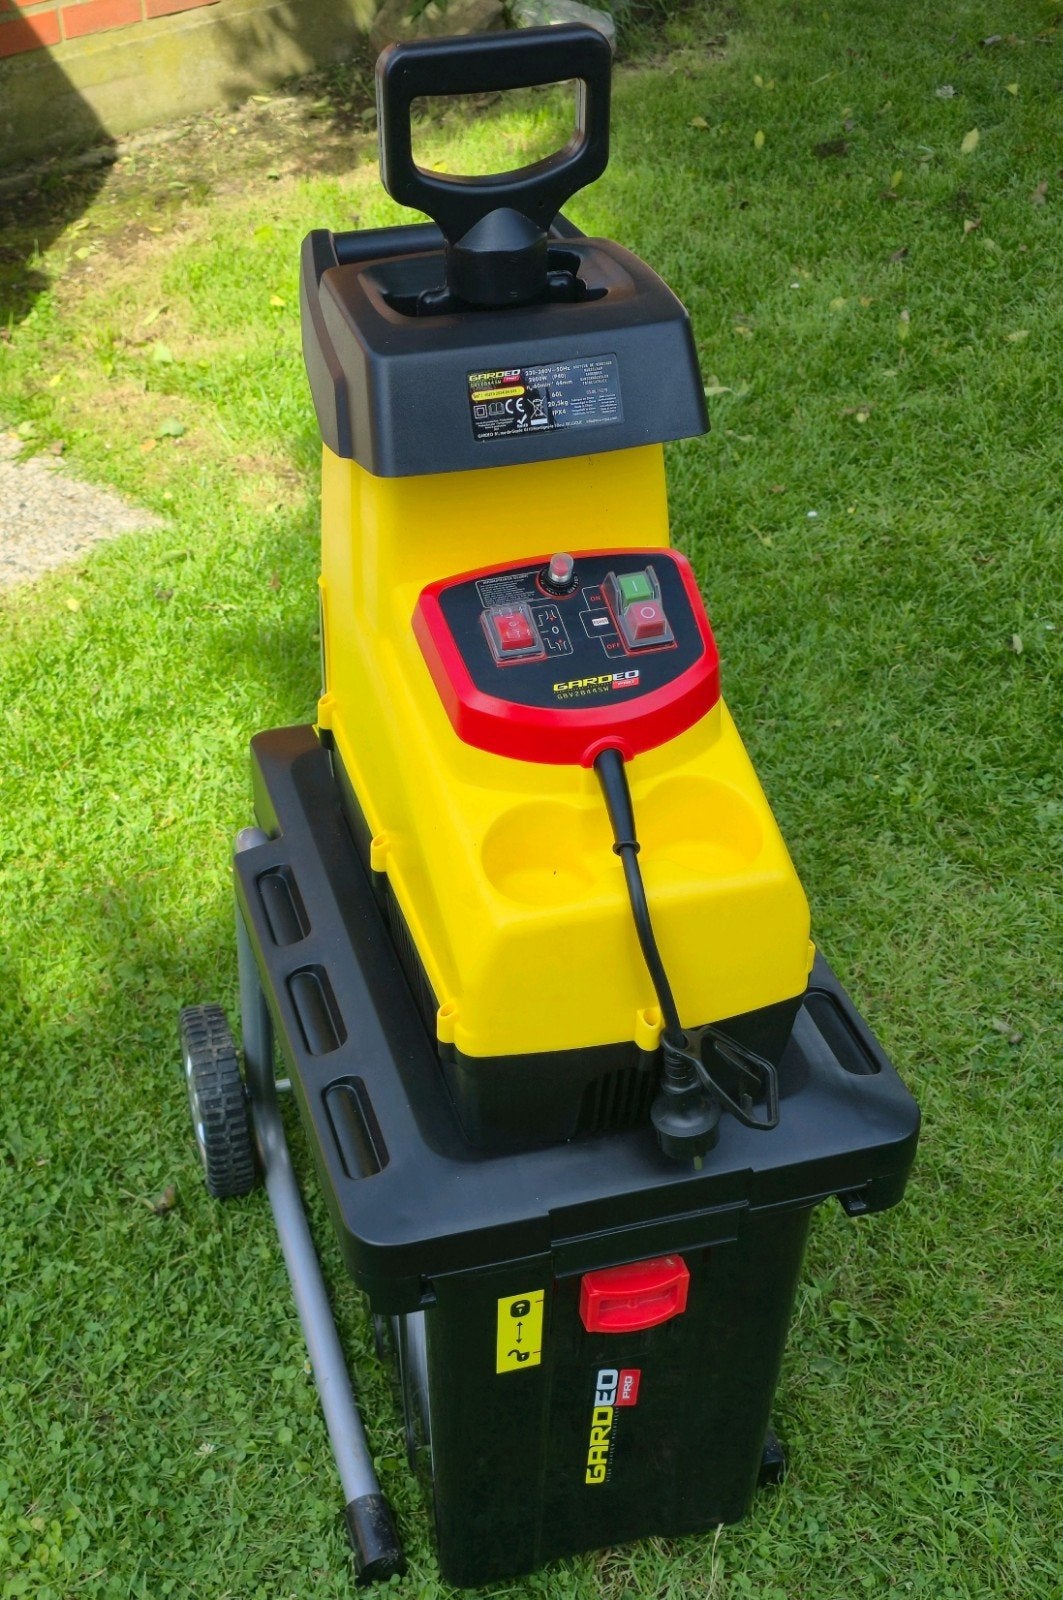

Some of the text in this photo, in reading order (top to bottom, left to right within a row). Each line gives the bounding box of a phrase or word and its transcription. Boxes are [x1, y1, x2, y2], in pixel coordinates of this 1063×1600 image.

[469, 369, 520, 382] GARDEO
[554, 670, 639, 692] GARDEO
[622, 1376, 633, 1399] PRO
[586, 1369, 618, 1484] GARDEO
